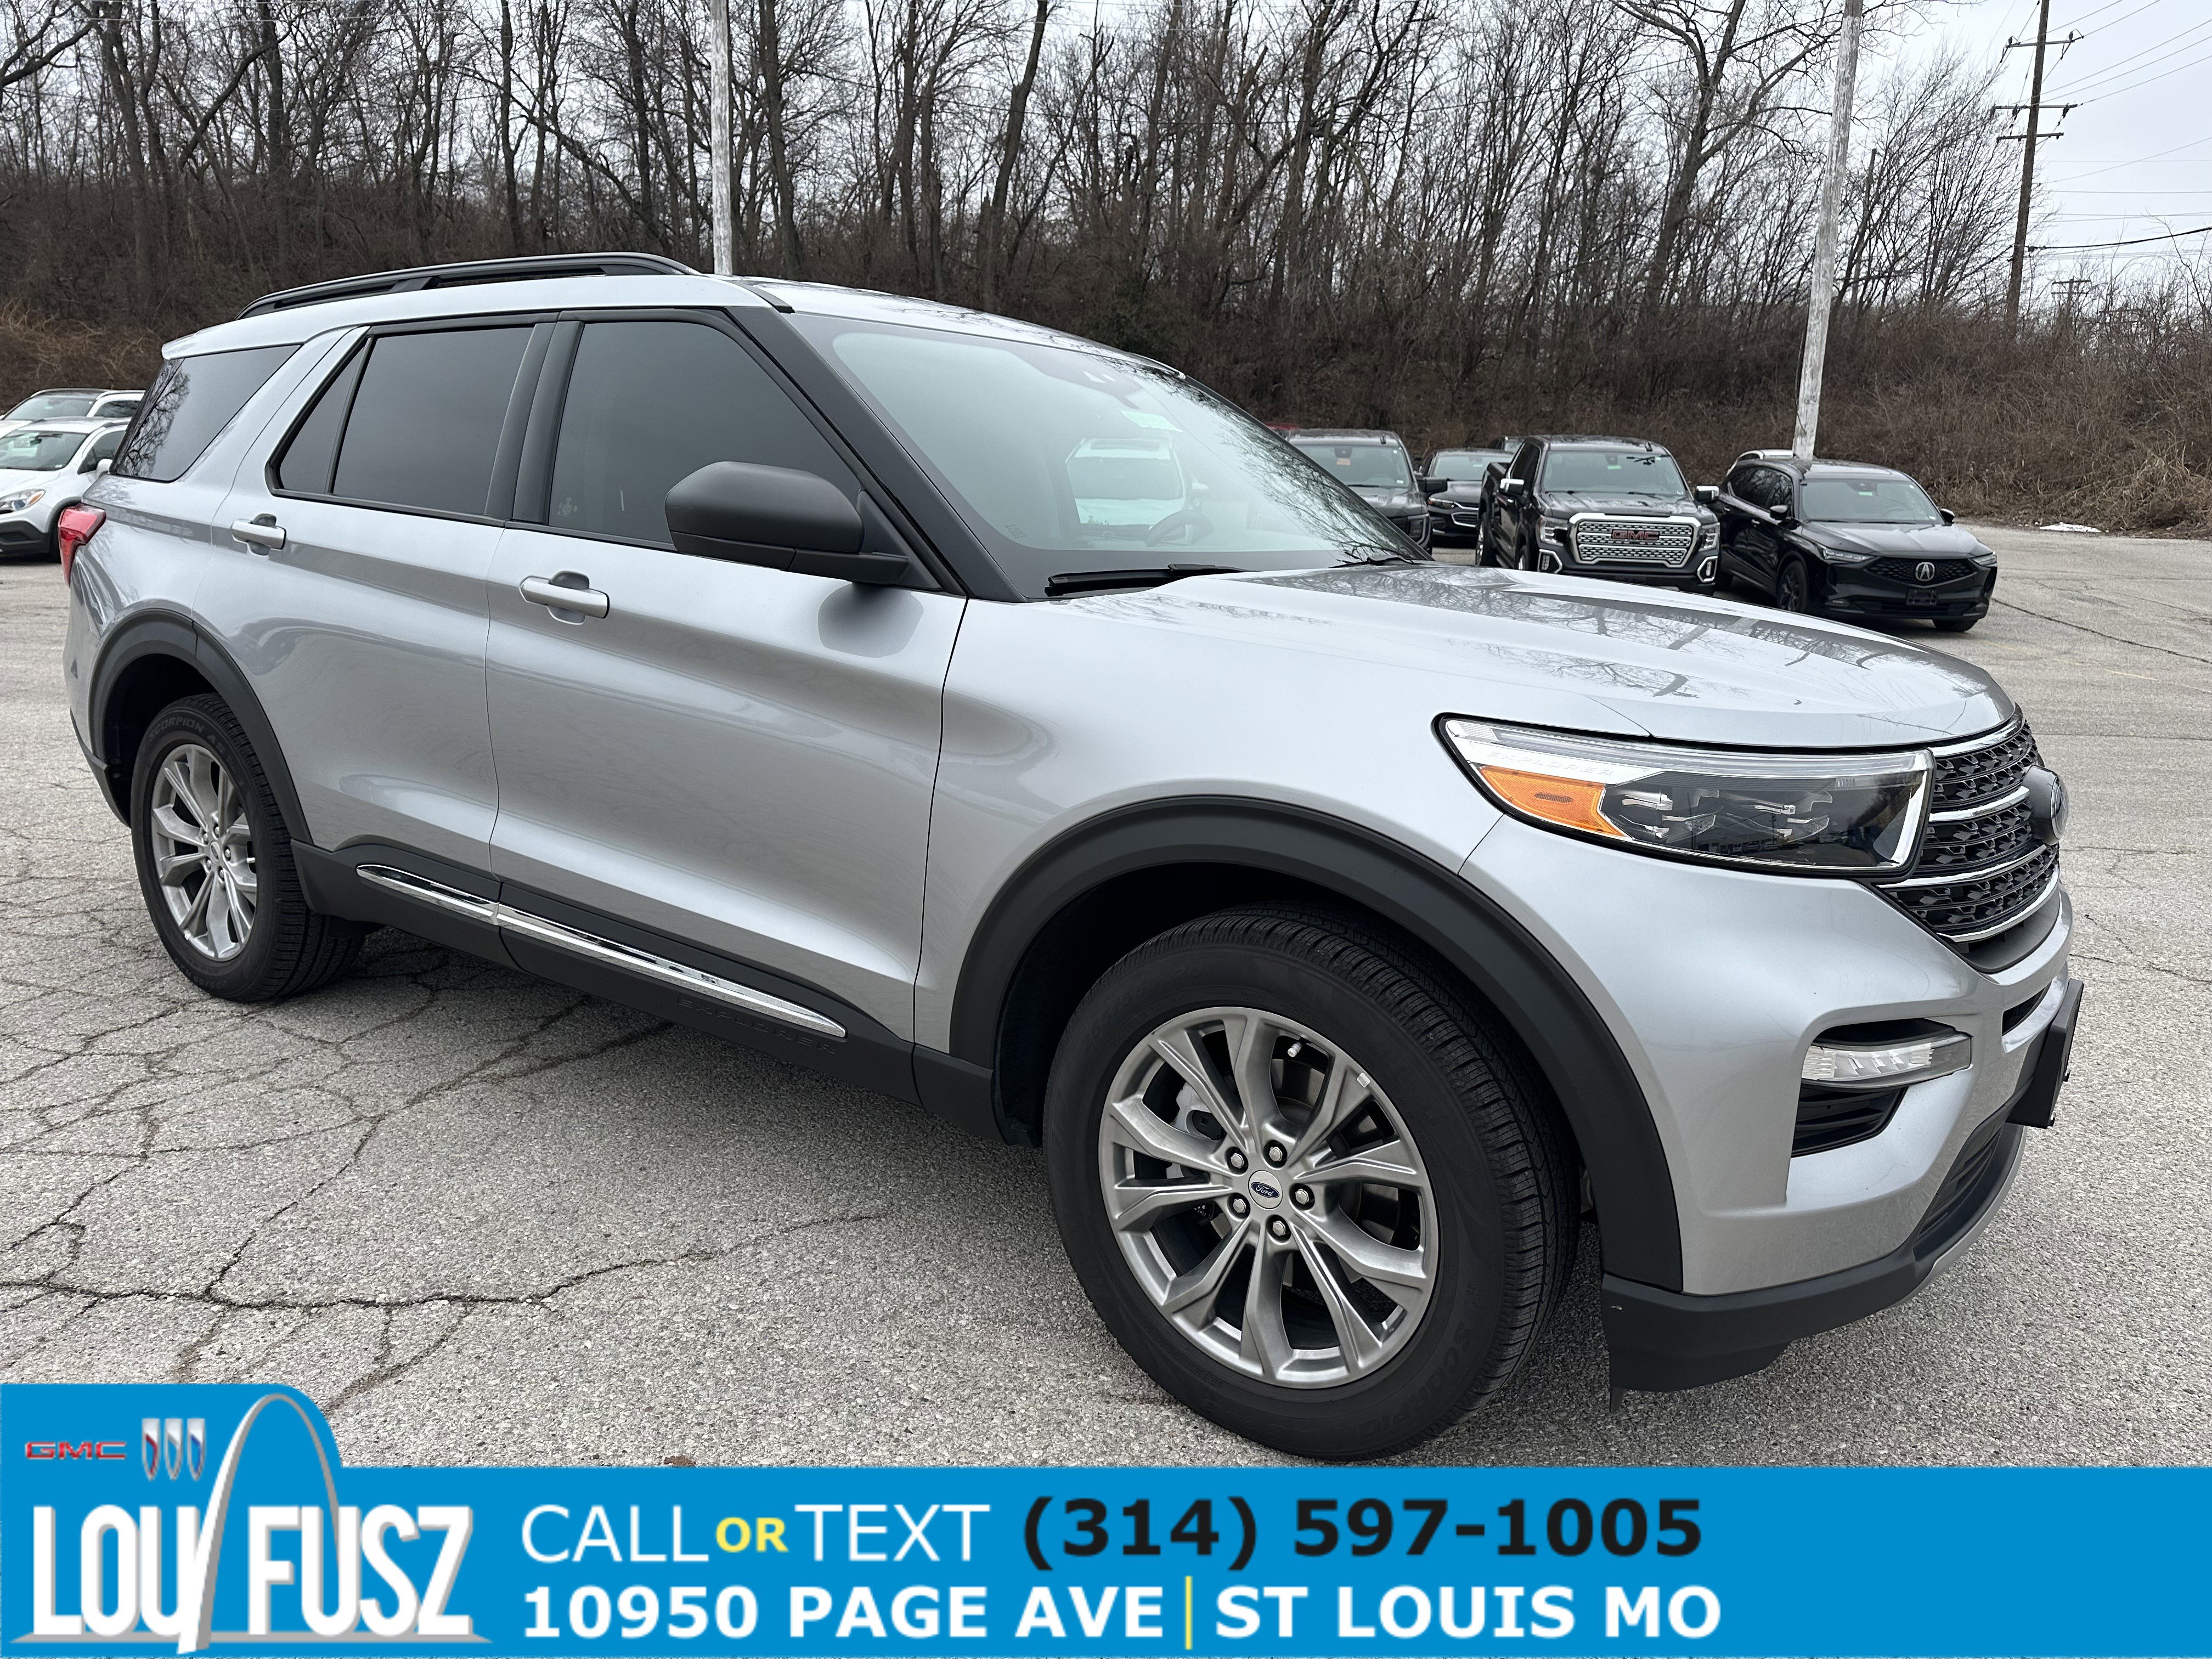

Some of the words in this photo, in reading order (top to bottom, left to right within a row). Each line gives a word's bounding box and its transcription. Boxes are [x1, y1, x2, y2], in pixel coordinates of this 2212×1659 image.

[1612, 529, 1660, 540] GMC
[149, 717, 205, 741] SCORPION
[1486, 751, 1615, 776] EXPLORER
[677, 997, 836, 1054] EXPLORER
[1255, 1184, 1274, 1196] Ford
